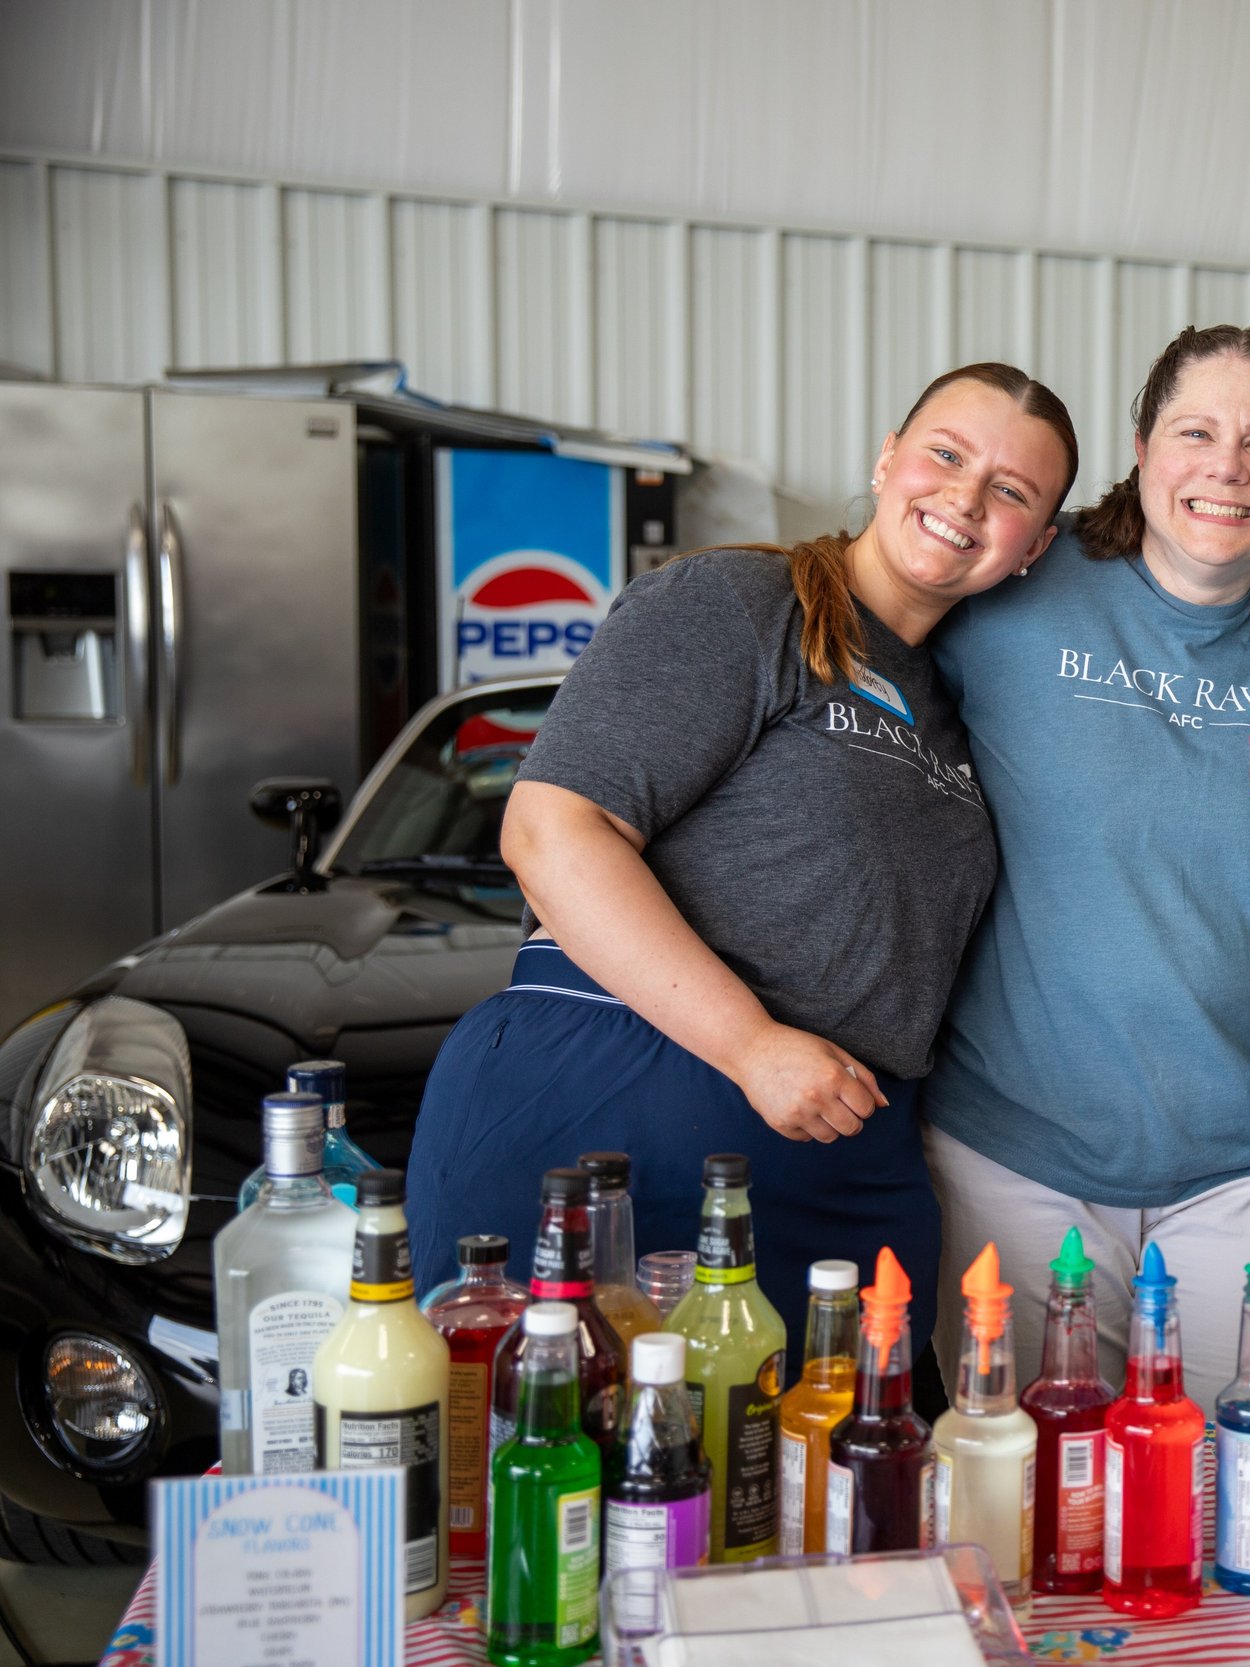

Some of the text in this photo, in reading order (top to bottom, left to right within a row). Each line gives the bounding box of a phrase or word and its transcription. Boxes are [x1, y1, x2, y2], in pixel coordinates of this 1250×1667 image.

[457, 621, 594, 660] PEPS
[1057, 648, 1184, 704] BLACK
[1168, 712, 1203, 729] AFC
[270, 1300, 324, 1312] SINCE 1795
[263, 1312, 331, 1322] OUR TEQUILA
[343, 1421, 399, 1431] Nutrition Facts
[343, 1446, 399, 1458] Calories 170
[641, 1508, 664, 1516] Facts
[208, 1511, 341, 1539] SNOW CONE
